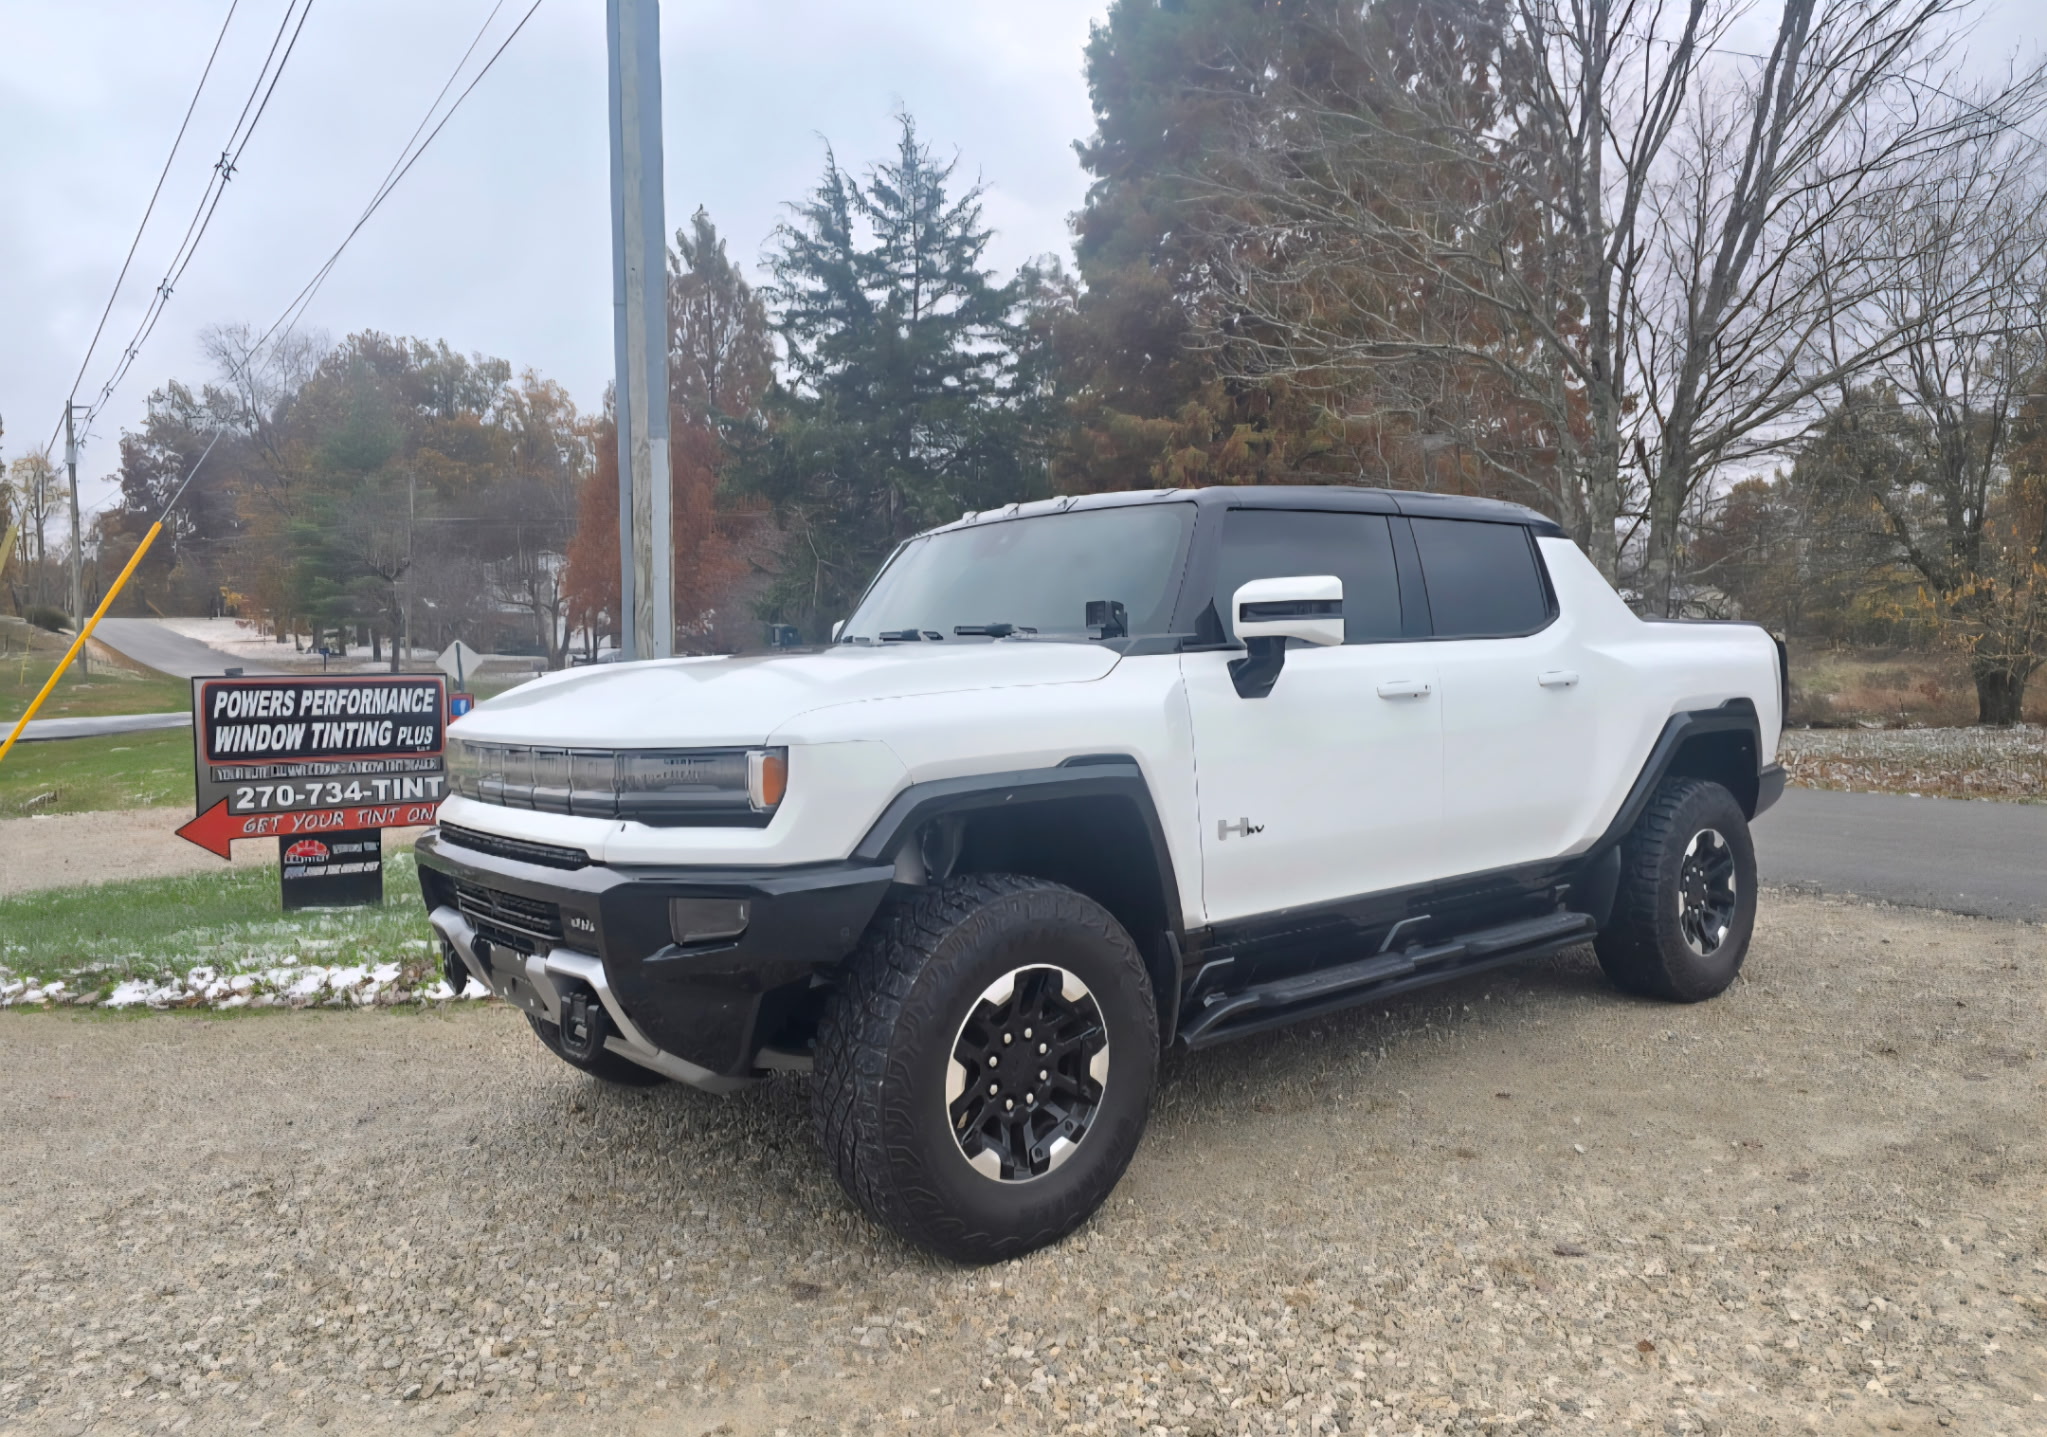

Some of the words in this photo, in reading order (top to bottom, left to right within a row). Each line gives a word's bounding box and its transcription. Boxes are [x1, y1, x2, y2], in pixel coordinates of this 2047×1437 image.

[213, 690, 295, 718] POWERS
[299, 688, 435, 716] PERFORMANCE
[214, 722, 306, 753] WINDOW
[311, 720, 393, 750] TINTING
[397, 725, 433, 747] PLUS
[236, 776, 445, 809] 270-734-TINT
[243, 815, 284, 833] GET
[292, 811, 345, 831] YOUR
[357, 807, 400, 825] TINT
